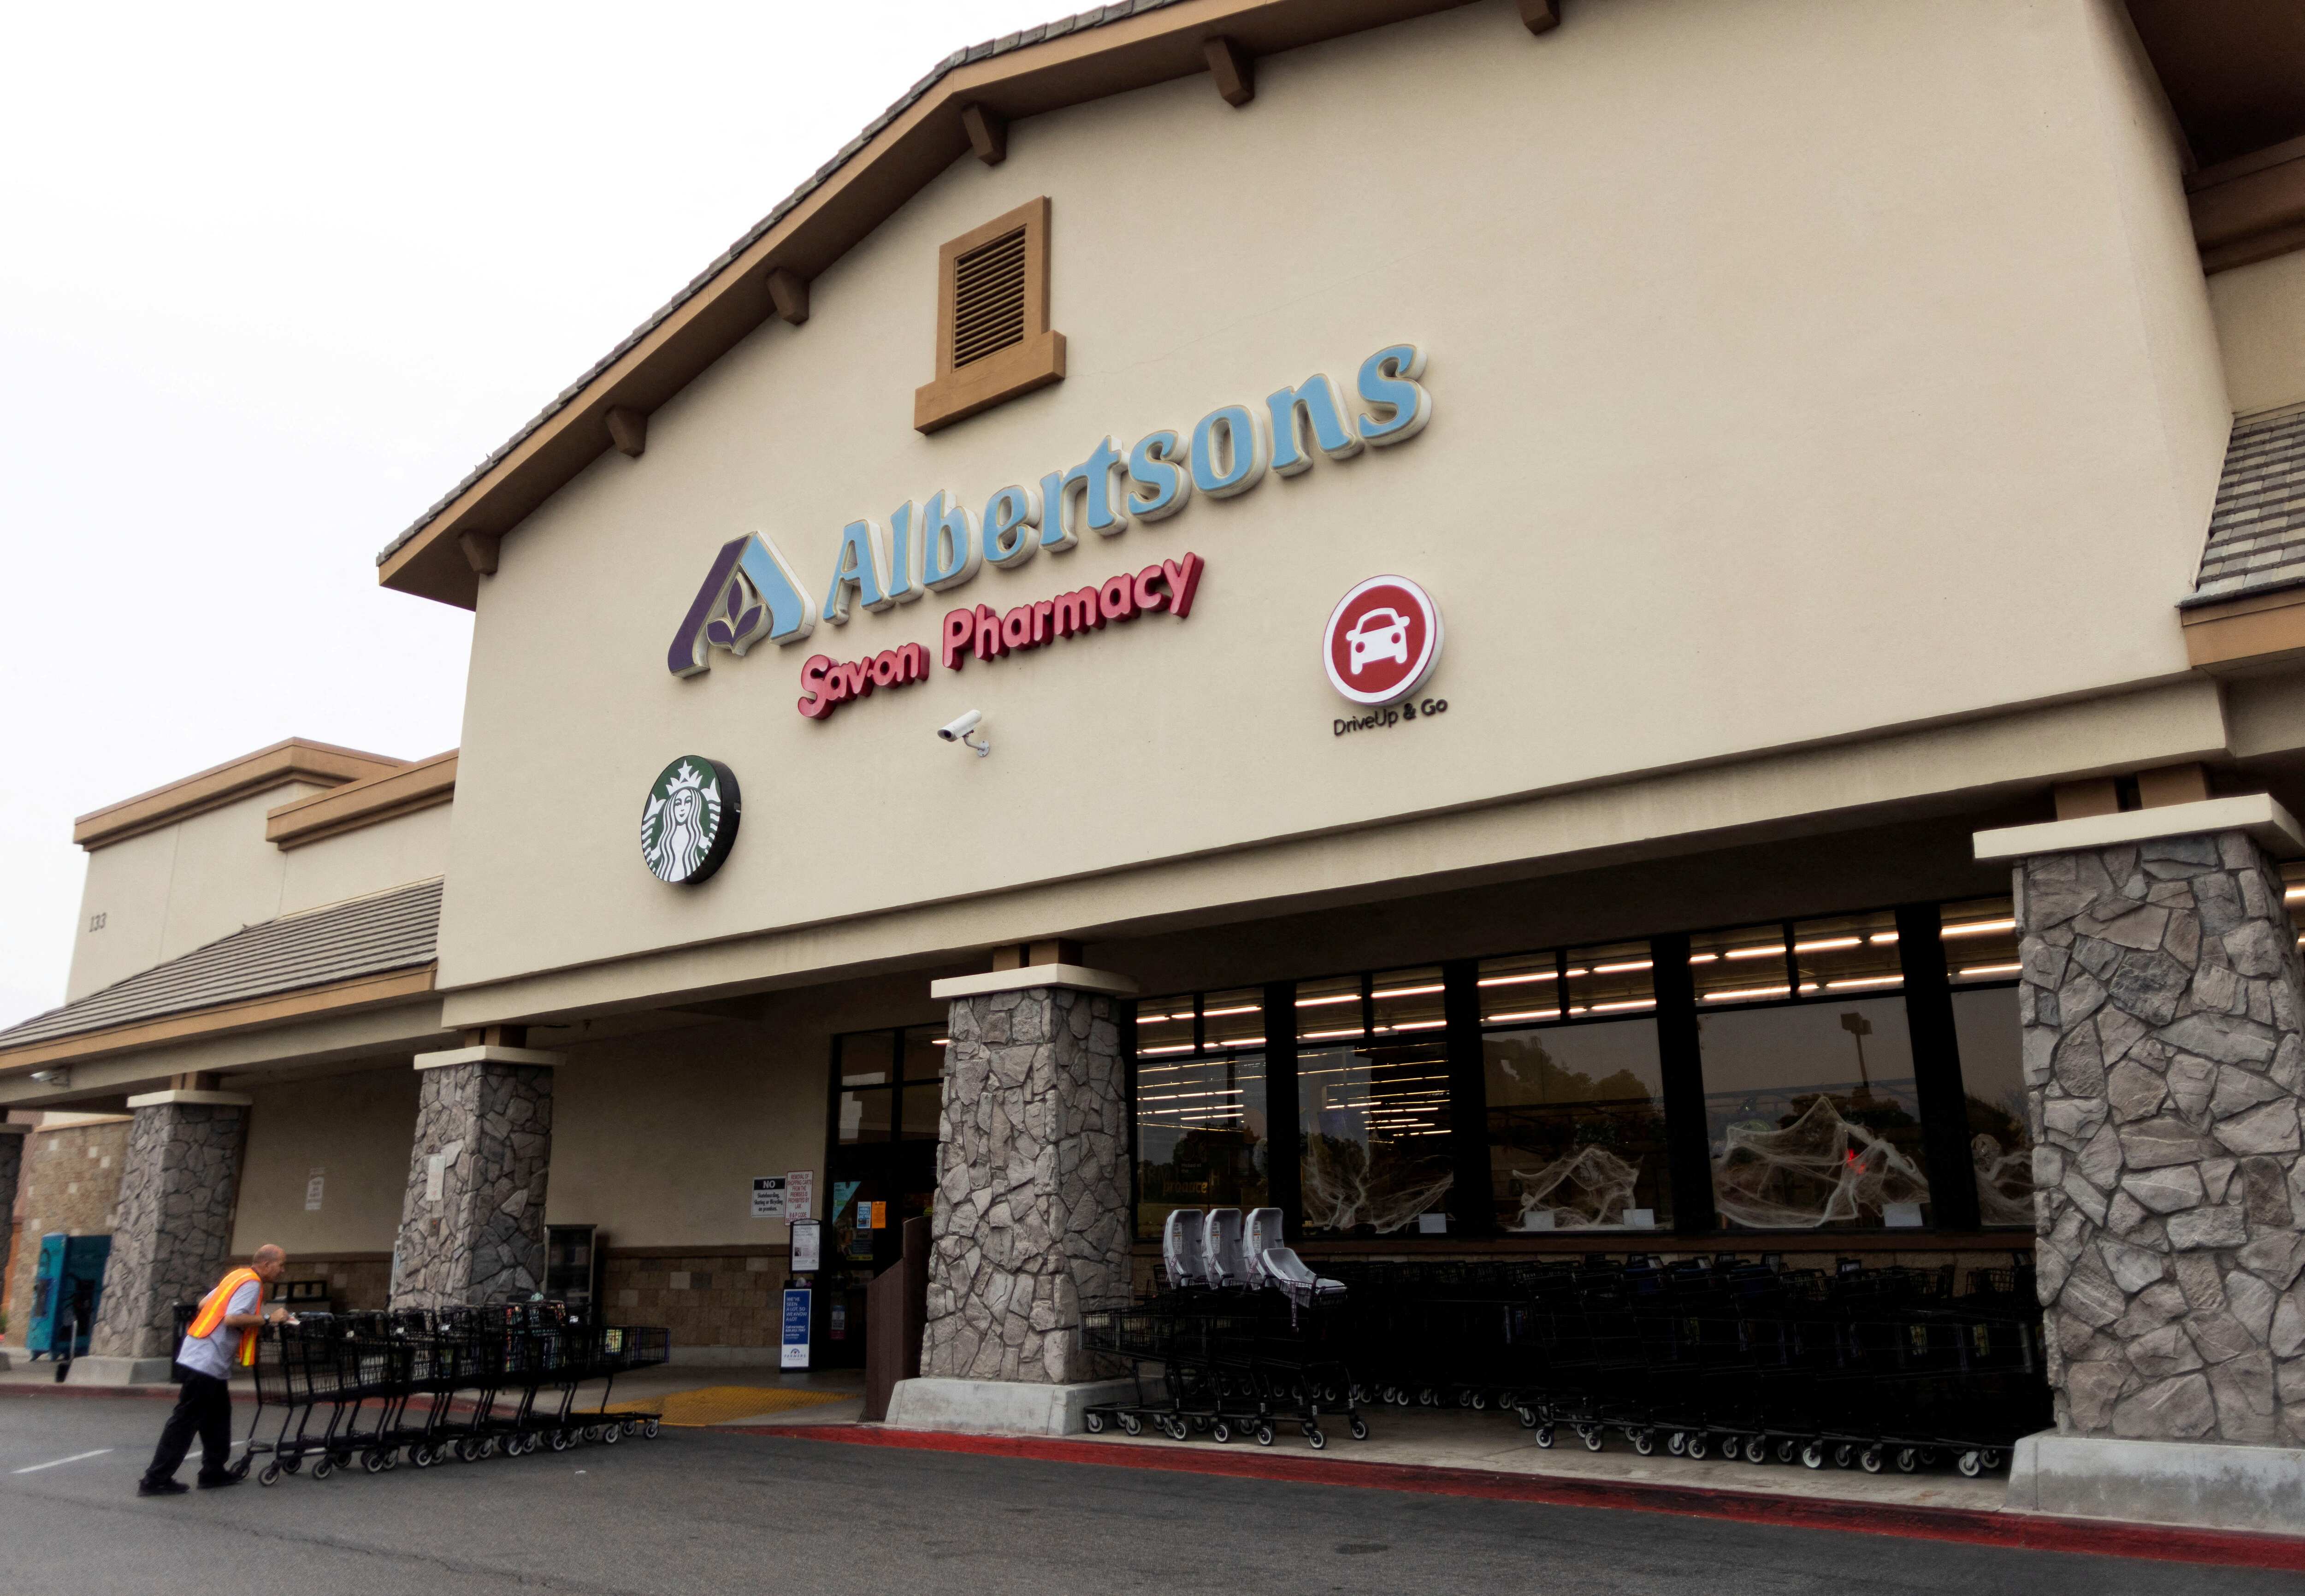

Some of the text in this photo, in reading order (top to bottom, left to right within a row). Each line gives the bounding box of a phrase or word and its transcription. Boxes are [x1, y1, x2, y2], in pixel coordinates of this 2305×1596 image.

[823, 343, 1432, 626] Albertsons
[943, 551, 1205, 671] Pharmacy
[1334, 698, 1448, 736] DriveUp & Go
[1163, 1180, 1208, 1195] produce
